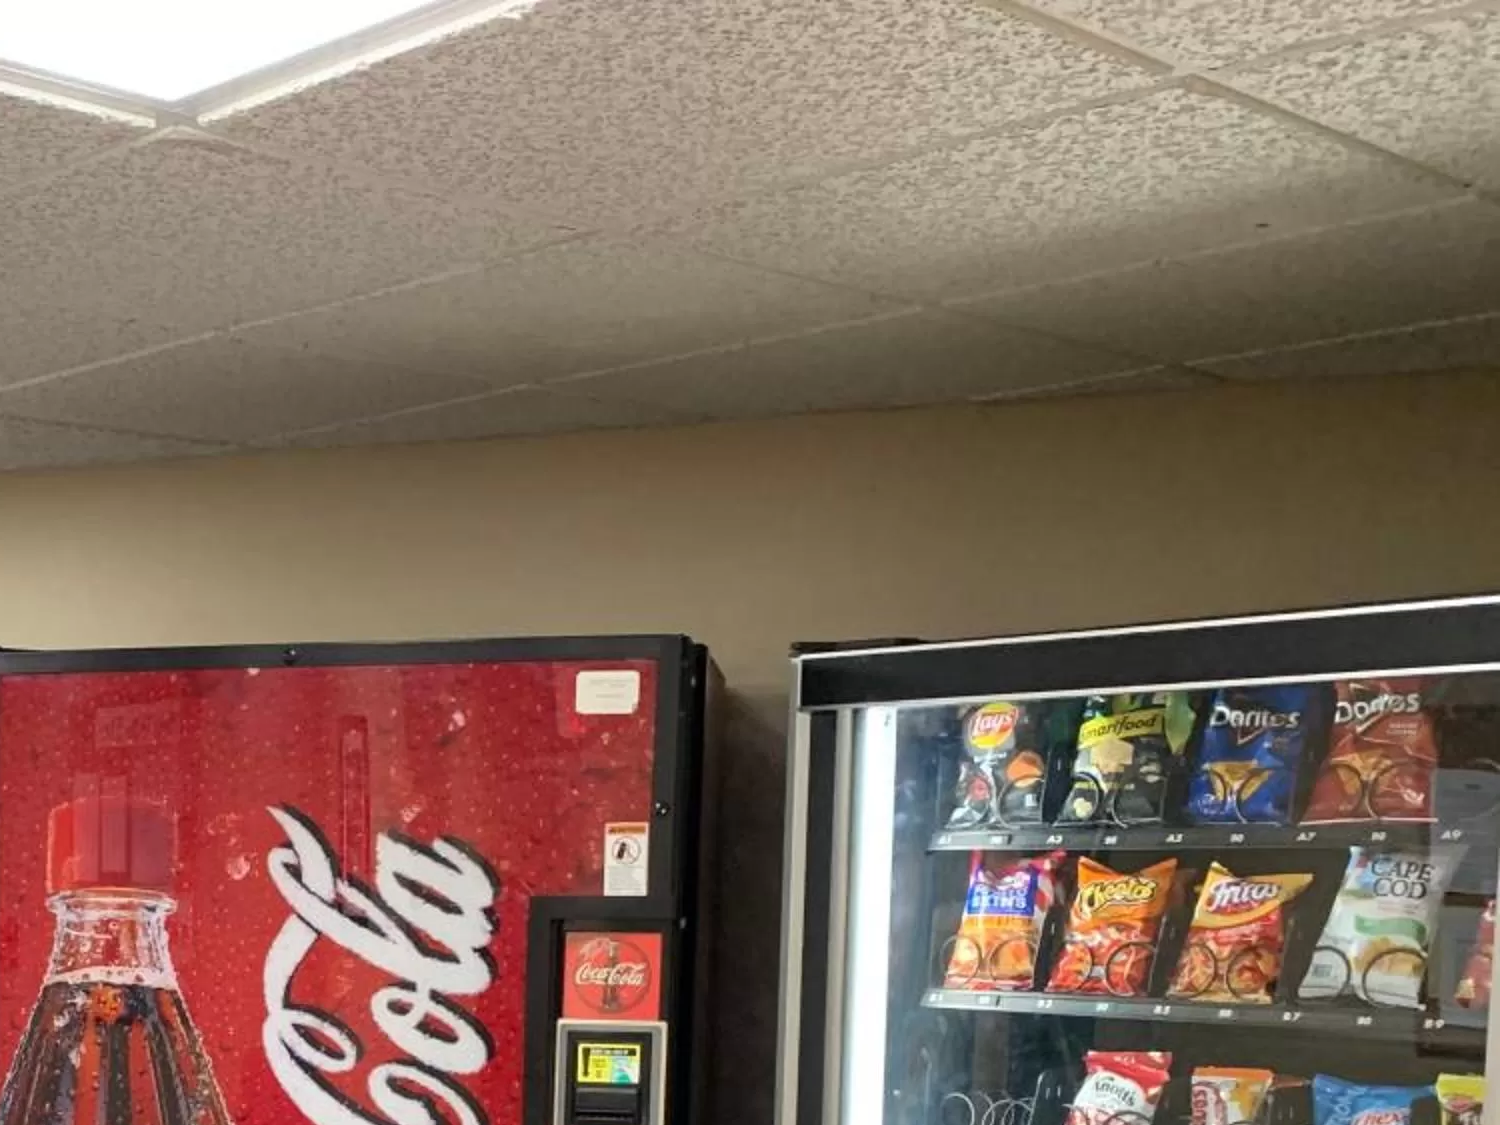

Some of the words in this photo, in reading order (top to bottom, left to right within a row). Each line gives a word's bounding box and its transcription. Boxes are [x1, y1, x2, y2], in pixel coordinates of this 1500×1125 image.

[1209, 704, 1301, 729] Doritos
[1334, 692, 1421, 725] Doritos
[1296, 831, 1317, 843] A7
[1440, 830, 1463, 841] A9
[1371, 856, 1436, 881] CAPE
[1079, 877, 1157, 918] Cheetos
[1206, 880, 1282, 912] Fritos
[1373, 878, 1429, 900] COD
[574, 960, 647, 986] Coca-Cola
